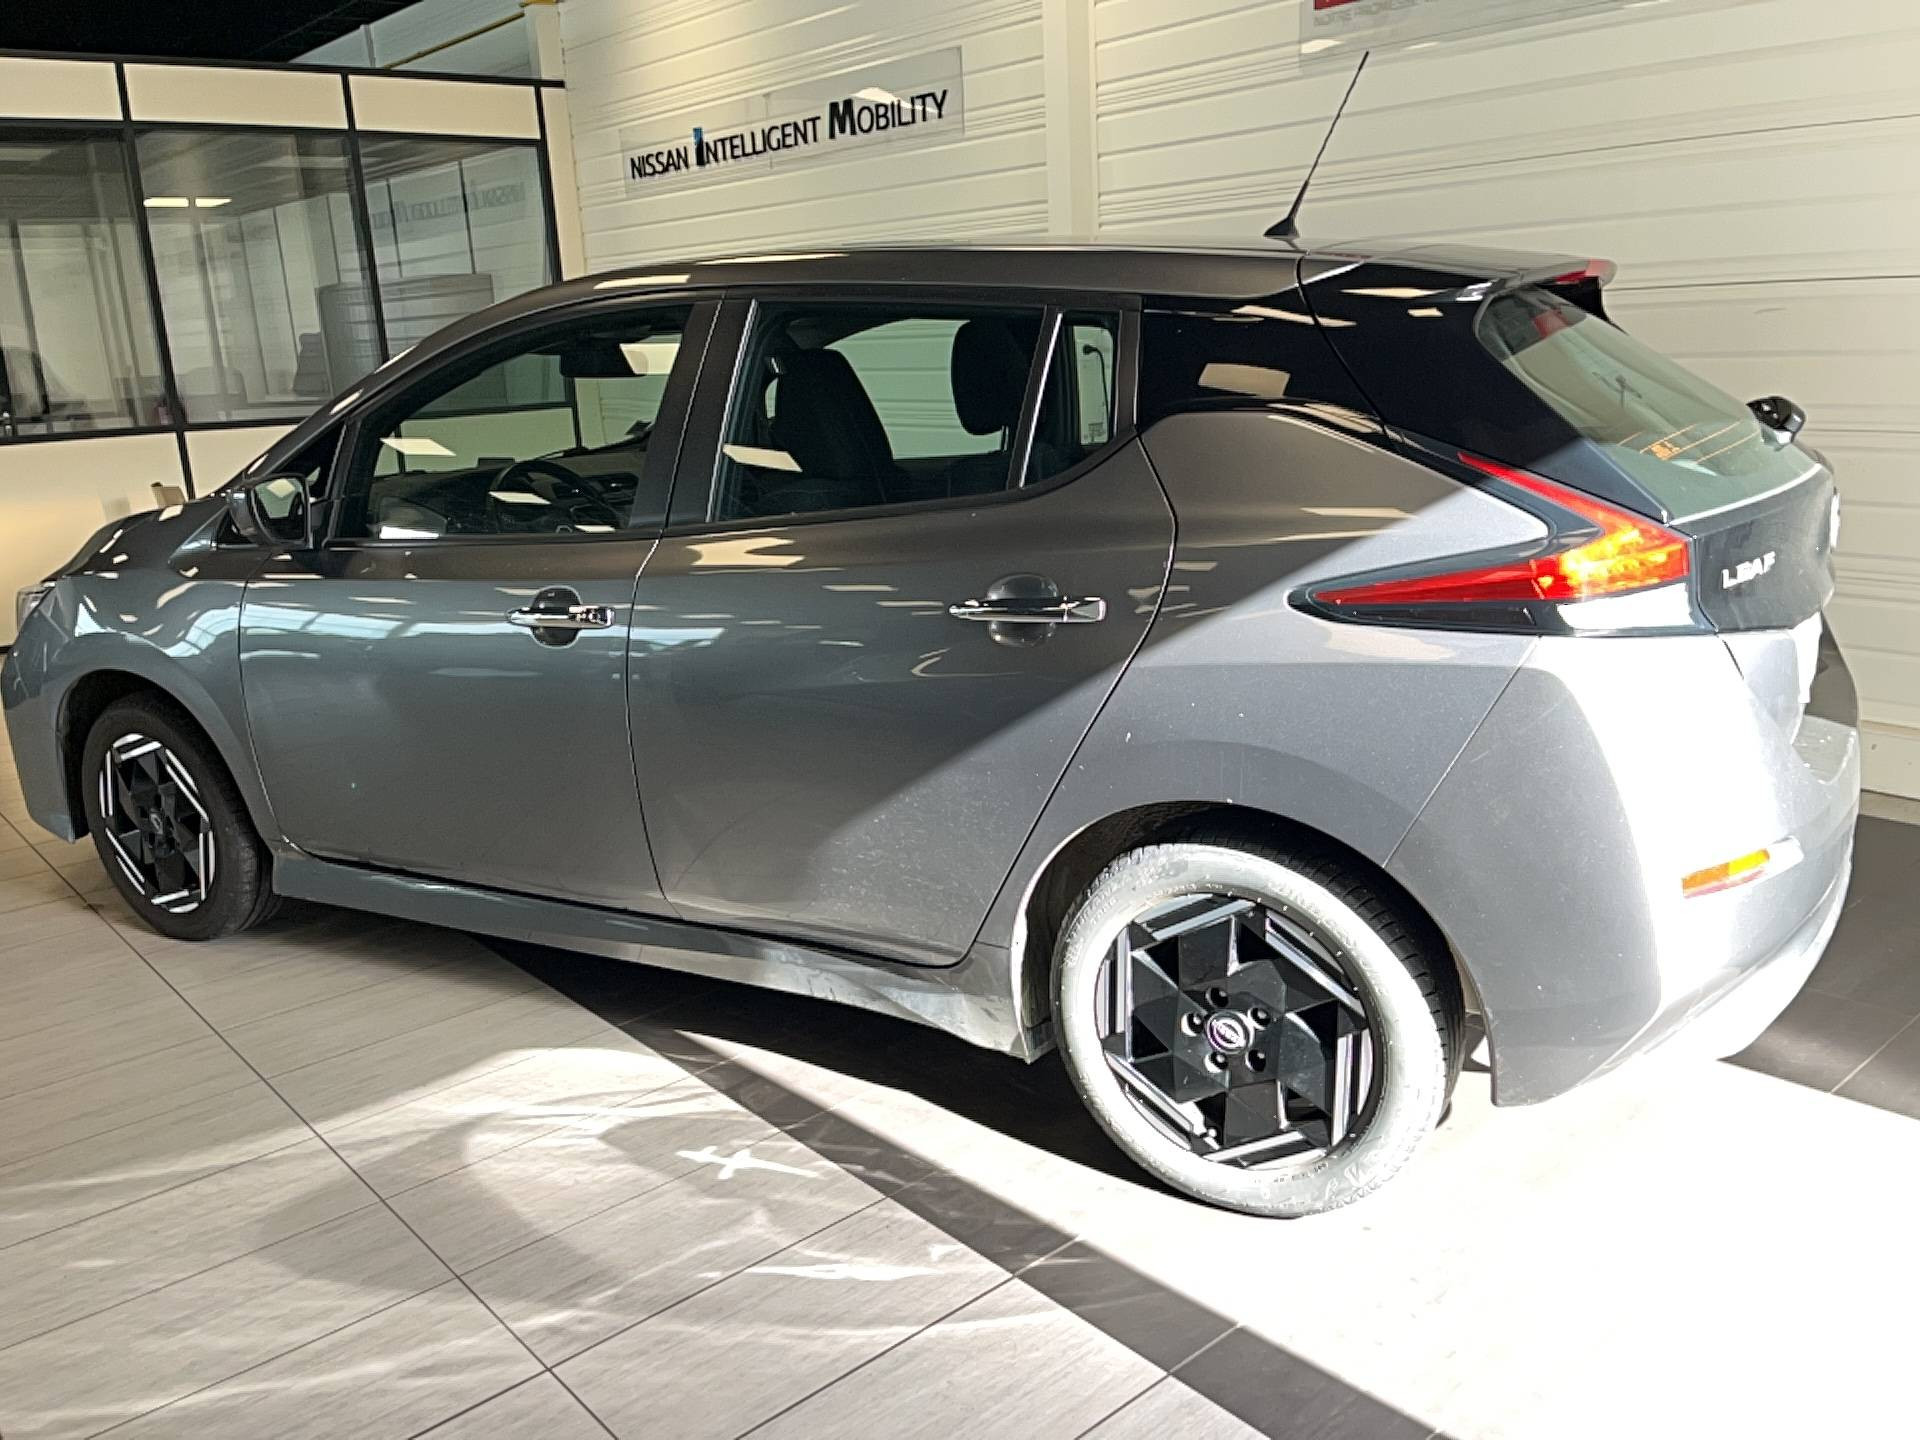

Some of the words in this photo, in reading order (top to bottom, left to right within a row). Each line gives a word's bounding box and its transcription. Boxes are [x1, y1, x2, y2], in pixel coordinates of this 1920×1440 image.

[630, 146, 690, 179] NISSAN
[693, 115, 821, 167] INTELLIGENT
[828, 89, 949, 139] MOBILITY
[1721, 551, 1776, 589] LEAF
